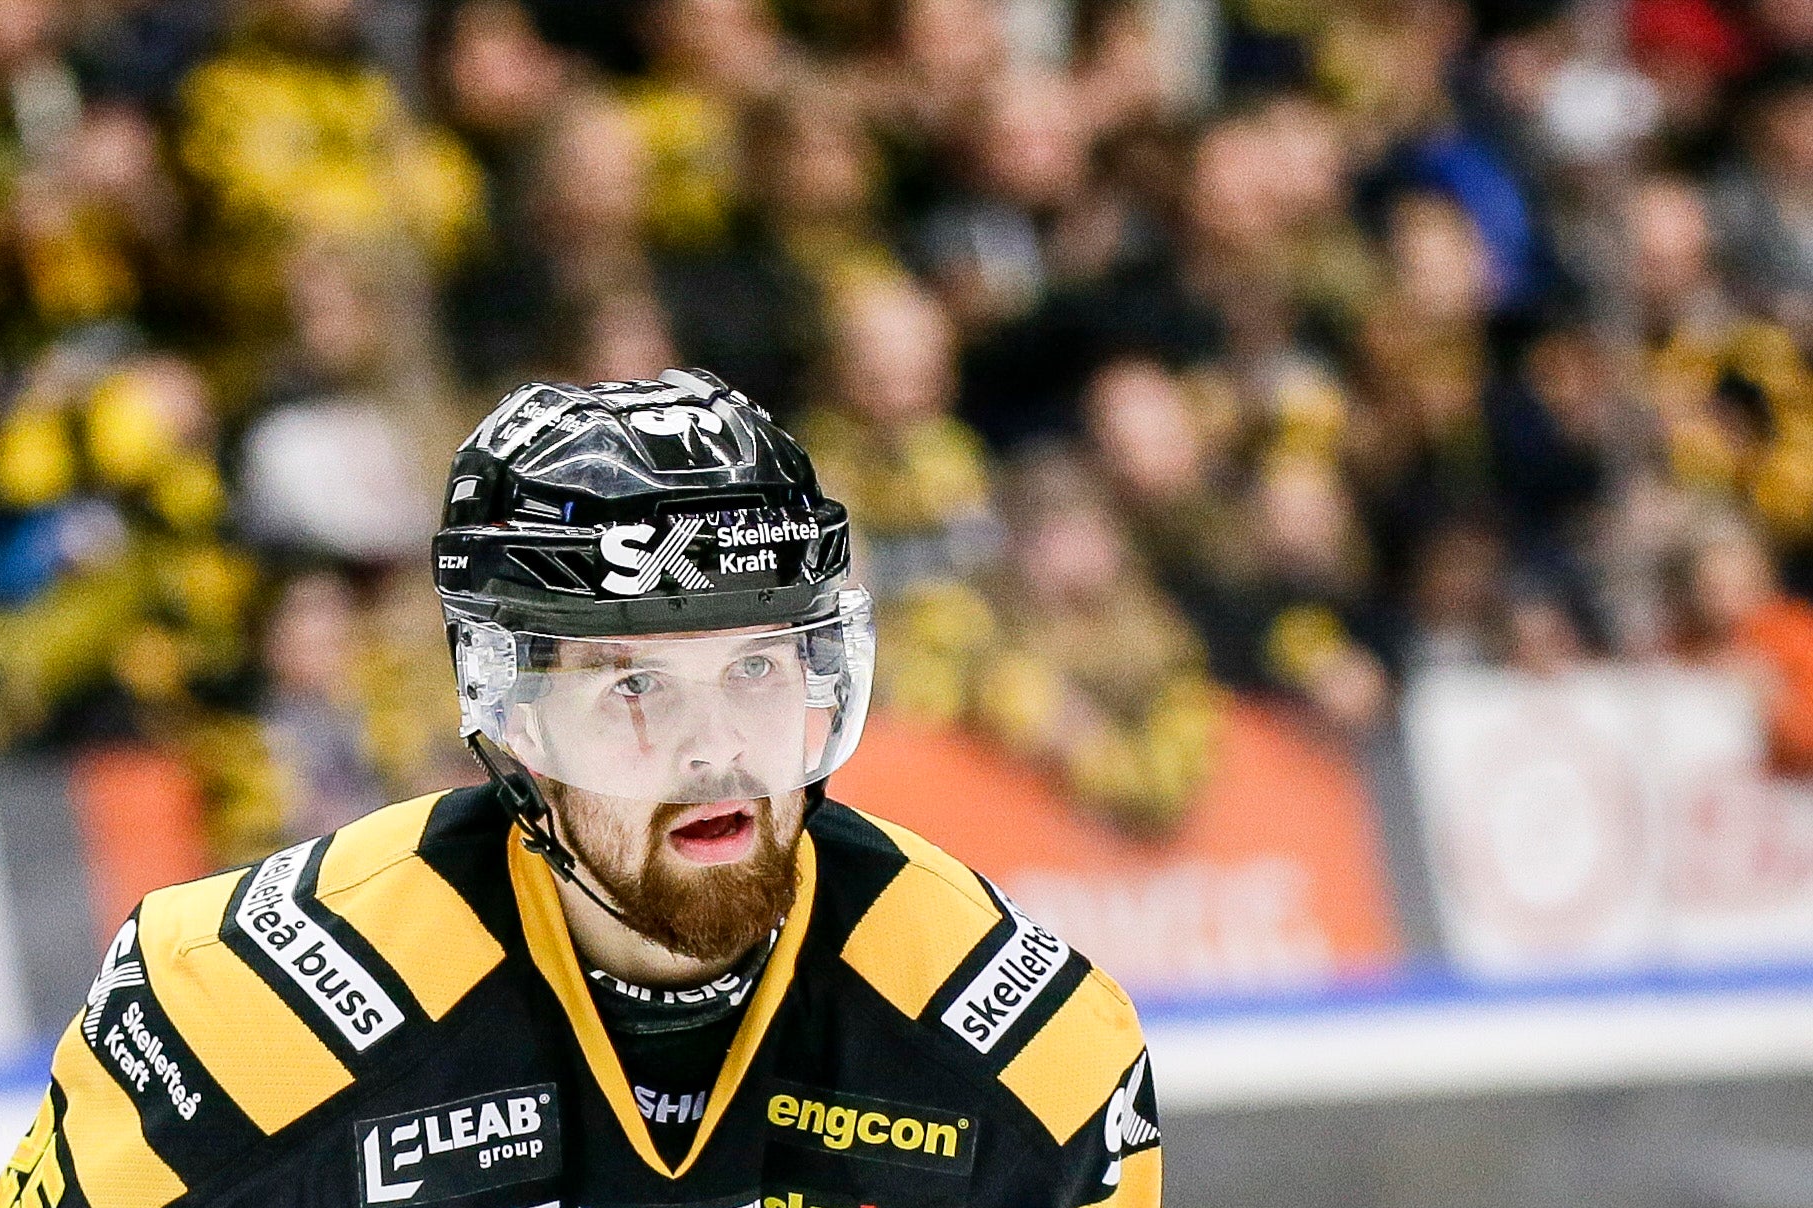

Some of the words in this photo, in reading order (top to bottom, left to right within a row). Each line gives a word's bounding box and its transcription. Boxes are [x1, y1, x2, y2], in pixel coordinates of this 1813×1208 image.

[438, 555, 469, 569] CCM
[717, 517, 820, 548] Skellefteå
[719, 549, 778, 575] Kraft
[291, 941, 383, 1035] buss
[962, 912, 1059, 1042] skellefte
[103, 1024, 150, 1093] Kraft
[122, 1001, 202, 1121] Skellefteå
[424, 1096, 542, 1154] LEAB
[478, 1139, 543, 1169] group
[767, 1094, 958, 1157] engcon
